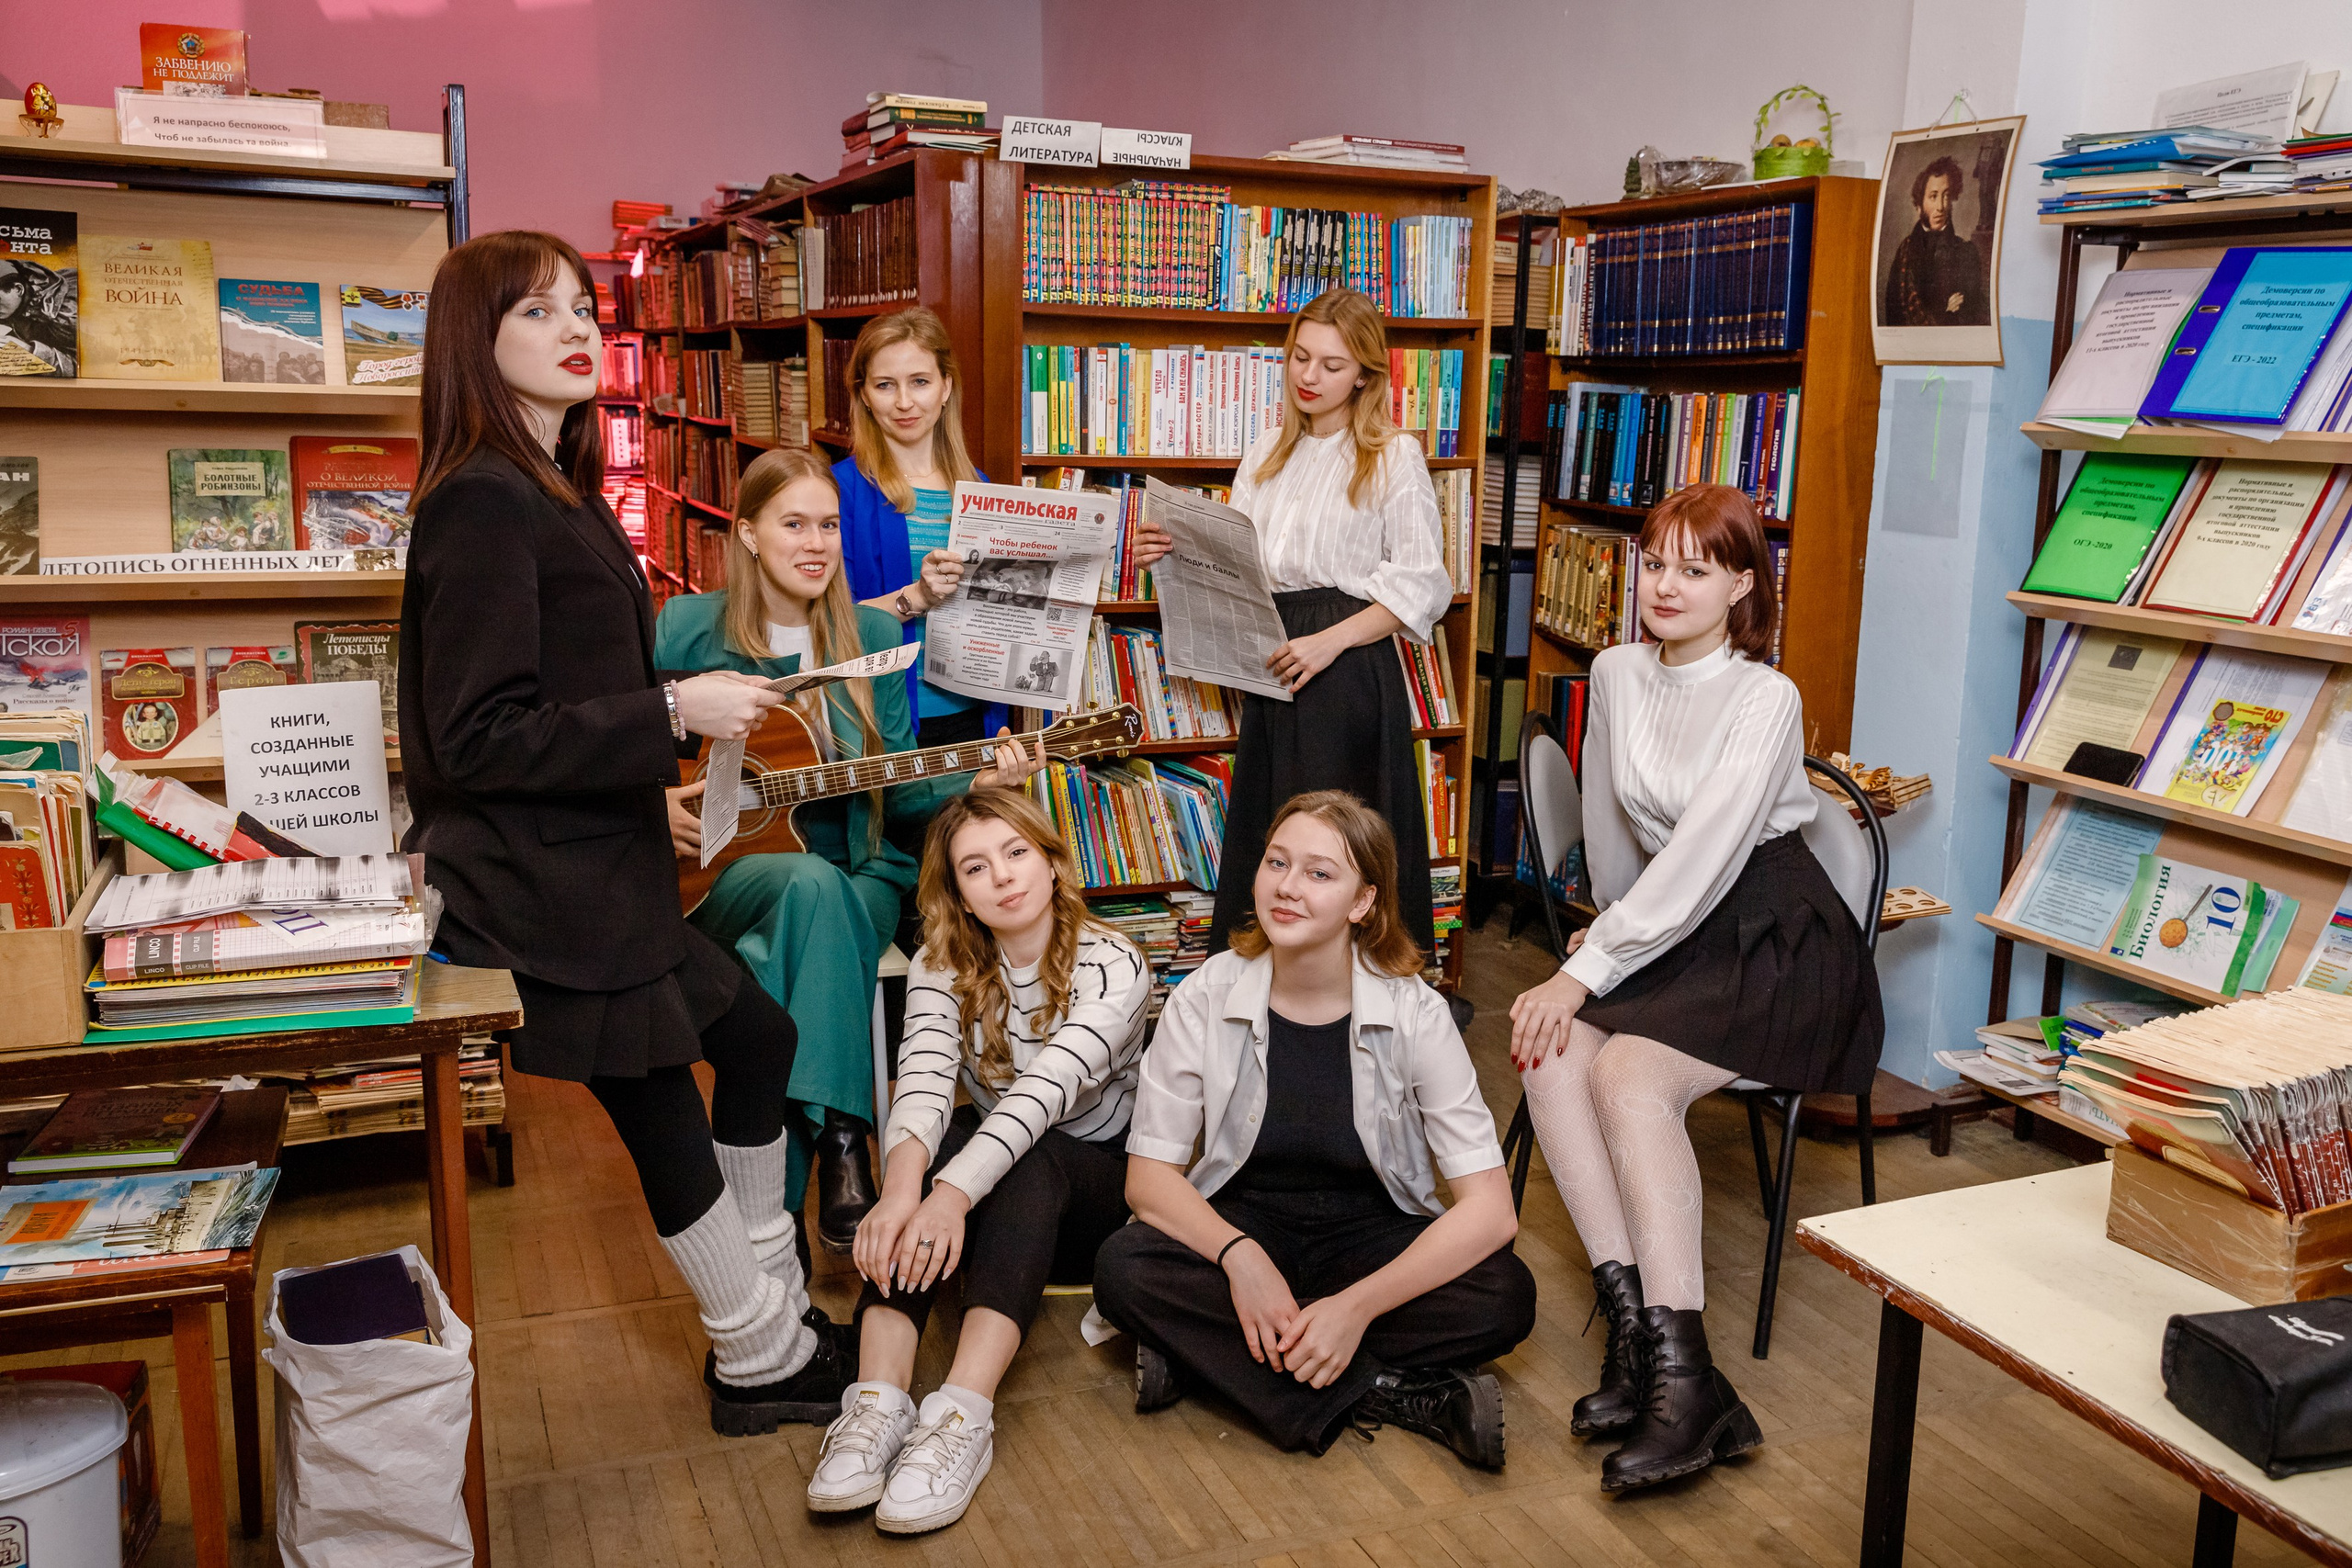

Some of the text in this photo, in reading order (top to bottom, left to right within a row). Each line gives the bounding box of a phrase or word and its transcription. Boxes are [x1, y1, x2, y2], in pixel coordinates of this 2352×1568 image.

[155, 57, 231, 73] ЗАБВЕНИЮ
[153, 68, 234, 83] НЕ ПОДЛЕЖИТ
[178, 118, 225, 129] напрасно
[228, 119, 290, 132] беспокоюсь,
[1012, 121, 1071, 137] ДЕТСКАЯ
[154, 132, 178, 141] Чтоб
[197, 135, 243, 145] забылась
[259, 139, 291, 147] война.
[1137, 132, 1182, 146] КЛАССЫ
[1009, 146, 1092, 164] ЛИТЕРАТУРА
[1113, 152, 1182, 167] НАЧАЛЬНЫЕ
[105, 263, 183, 276] ВЕЛИКАЯ
[105, 277, 183, 287] ОТЕЧЕСТВЕННАЯ
[238, 284, 304, 296] СУДЬБА
[2260, 286, 2312, 296] Демоверсии
[106, 287, 183, 306] ВОЙНА
[2239, 298, 2335, 308] общеобразовательным
[2255, 312, 2302, 321] предметам,
[2242, 322, 2304, 332] спецификации
[360, 360, 392, 372] Город
[1771, 429, 1780, 471] ГЕОЛОГИЯ
[1679, 434, 1689, 484] ЭНЦИКЛОПЕДИЯ
[1749, 434, 1759, 487] ЭНЦИКЛОПЕДИЯ
[204, 474, 257, 482] БОЛОТНЫЕ
[321, 472, 397, 482] О ВЕЛИКОЙ
[2097, 478, 2143, 487] Демоверсии
[2238, 478, 2287, 487] Нормативные
[307, 480, 380, 489] ОТЕЧЕСТВЕННОЙ
[2228, 488, 2294, 497] распорядительные
[961, 494, 1078, 521] учительская
[2257, 498, 2305, 507] организации
[2234, 505, 2277, 513] проведению
[2082, 510, 2137, 522] спецификации
[2218, 513, 2276, 522] государственной
[1045, 519, 1075, 527] газета
[2239, 523, 2279, 532] аттестации
[2214, 529, 2260, 538] выпускников
[989, 536, 1058, 551] Чтобы ребенок
[2074, 538, 2091, 547] ОГЭ
[1006, 549, 1054, 559] услышал...
[43, 560, 164, 575] ЛЕТОПИСЬ
[172, 556, 300, 572] ОГНЕННЫХ
[1213, 563, 1240, 580] баллы
[61, 621, 79, 637] 5
[322, 633, 390, 644] Летописцы
[969, 638, 1001, 648] Униженные
[328, 644, 387, 656] ПОБЕДЫ
[967, 645, 1005, 656] оскорбленные
[230, 677, 274, 687] Герои
[270, 713, 330, 728] КНИГИ,
[250, 735, 355, 754] СОЗДАННЫЕ
[259, 759, 350, 778] УЧАЩИМИ
[254, 784, 361, 806] 2-3 КЛАССОВ
[270, 810, 379, 831] ШЕЙ ШКОЛЫ
[2128, 865, 2171, 960] Биология
[2206, 886, 2241, 935] 10
[149, 938, 161, 959] LINCO
